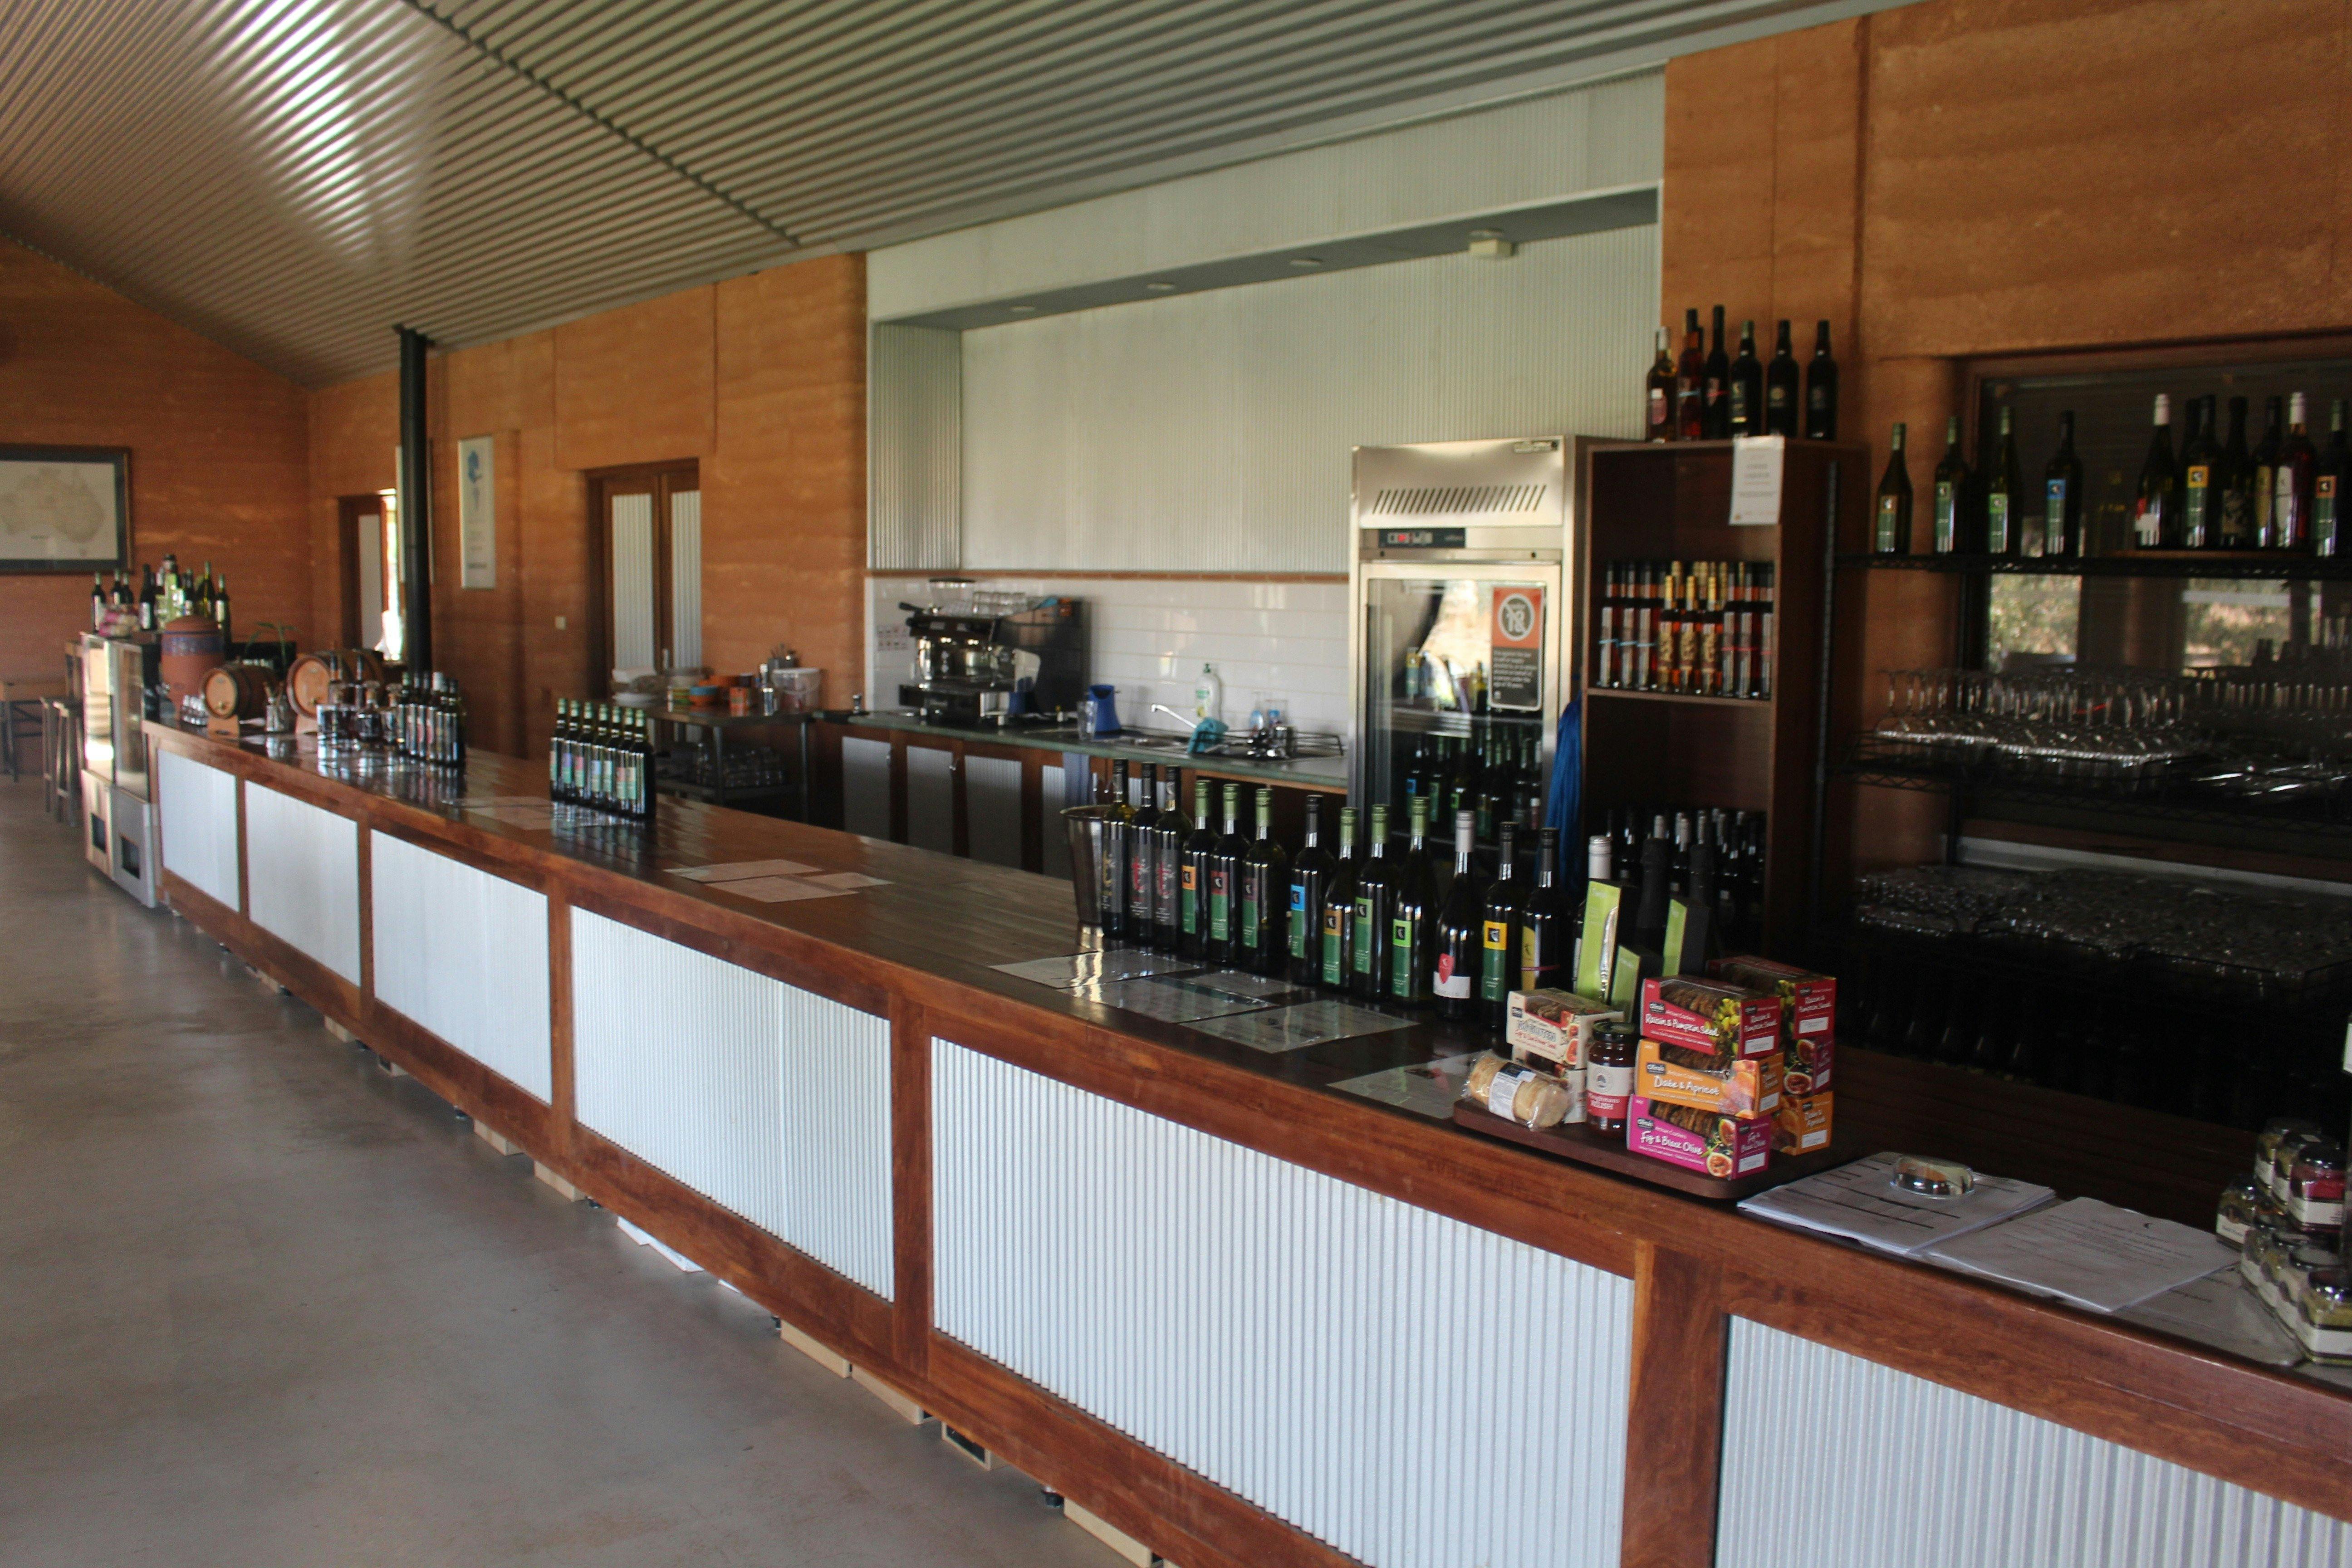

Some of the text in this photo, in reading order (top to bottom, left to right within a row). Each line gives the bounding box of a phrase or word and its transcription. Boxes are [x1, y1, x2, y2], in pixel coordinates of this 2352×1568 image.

[1646, 1013, 1666, 1025] Raisin
[1672, 1018, 1700, 1033] Pumpkin
[1700, 1025, 1720, 1037] Seed
[1654, 1075, 1678, 1088] Date
[1686, 1081, 1720, 1095] Apricot
[1640, 1130, 1703, 1155] Fig & Black Olive
